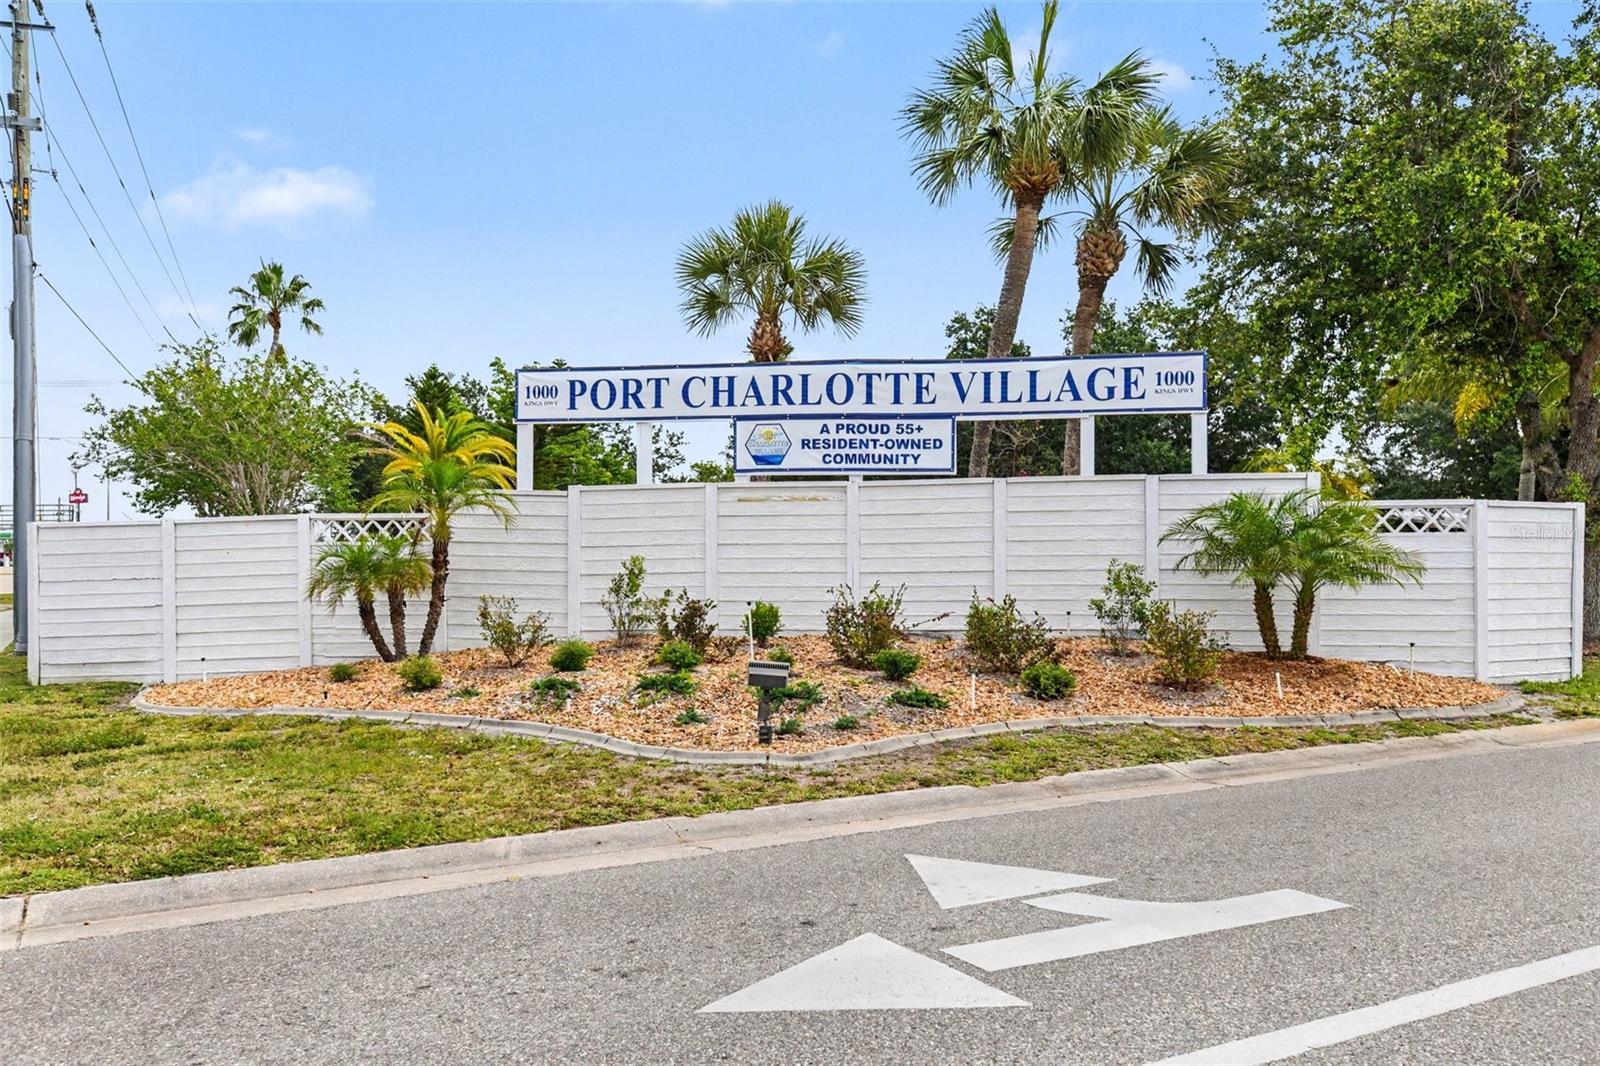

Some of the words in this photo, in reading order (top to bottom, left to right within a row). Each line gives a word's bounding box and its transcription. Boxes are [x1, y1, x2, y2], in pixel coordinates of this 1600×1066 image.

[1155, 370, 1195, 386] 1000
[525, 385, 558, 399] 1000
[567, 378, 669, 410] PORT
[682, 372, 937, 408] CHARLOTTE
[950, 366, 1146, 404] VILLAGE
[819, 424, 830, 434] A
[835, 424, 891, 435] PROUD
[895, 424, 924, 434] 55+
[801, 438, 943, 450] RESIDENT-OWNED
[822, 453, 921, 465] COMMUNITY
